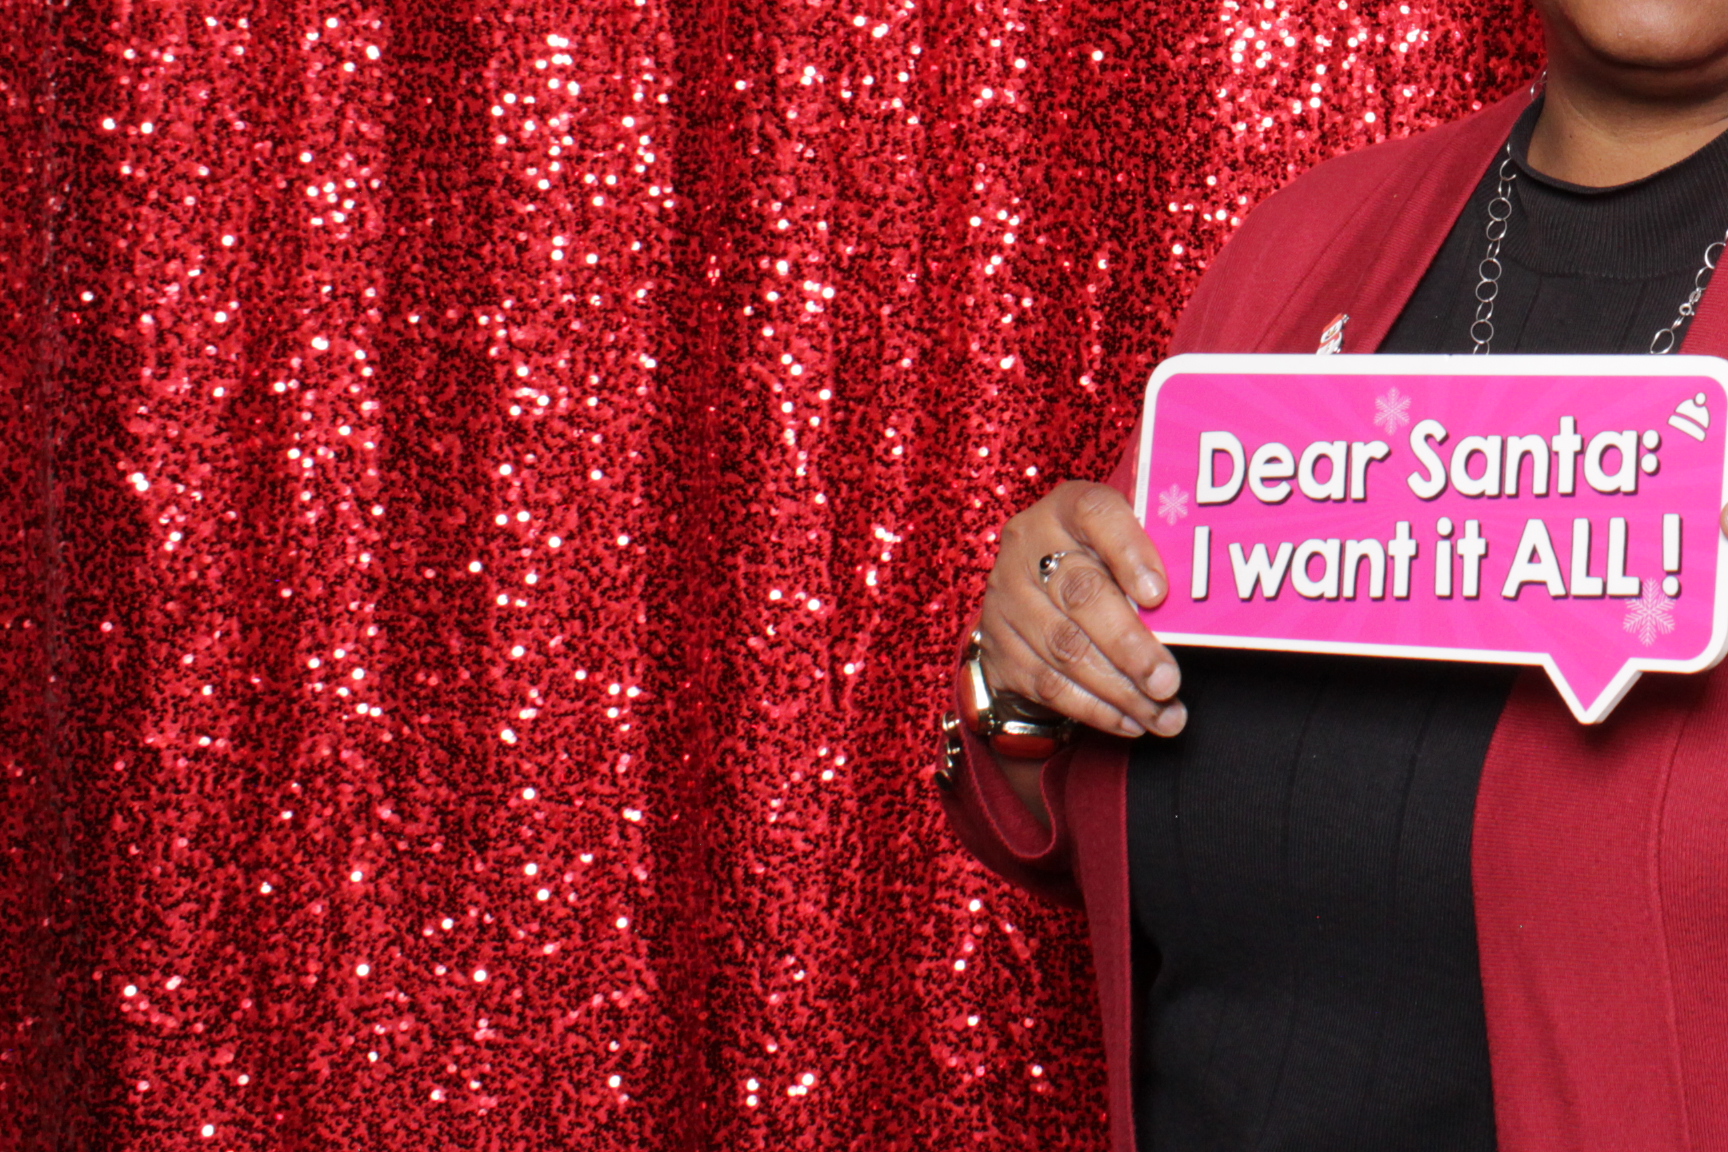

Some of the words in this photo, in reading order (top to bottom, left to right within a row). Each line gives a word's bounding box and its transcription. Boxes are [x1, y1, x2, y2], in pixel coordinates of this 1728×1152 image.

[1195, 430, 1391, 505] Dear
[1407, 416, 1660, 500] Santa:
[1191, 525, 1211, 600] I
[1228, 520, 1418, 600] want
[1434, 516, 1488, 598] it
